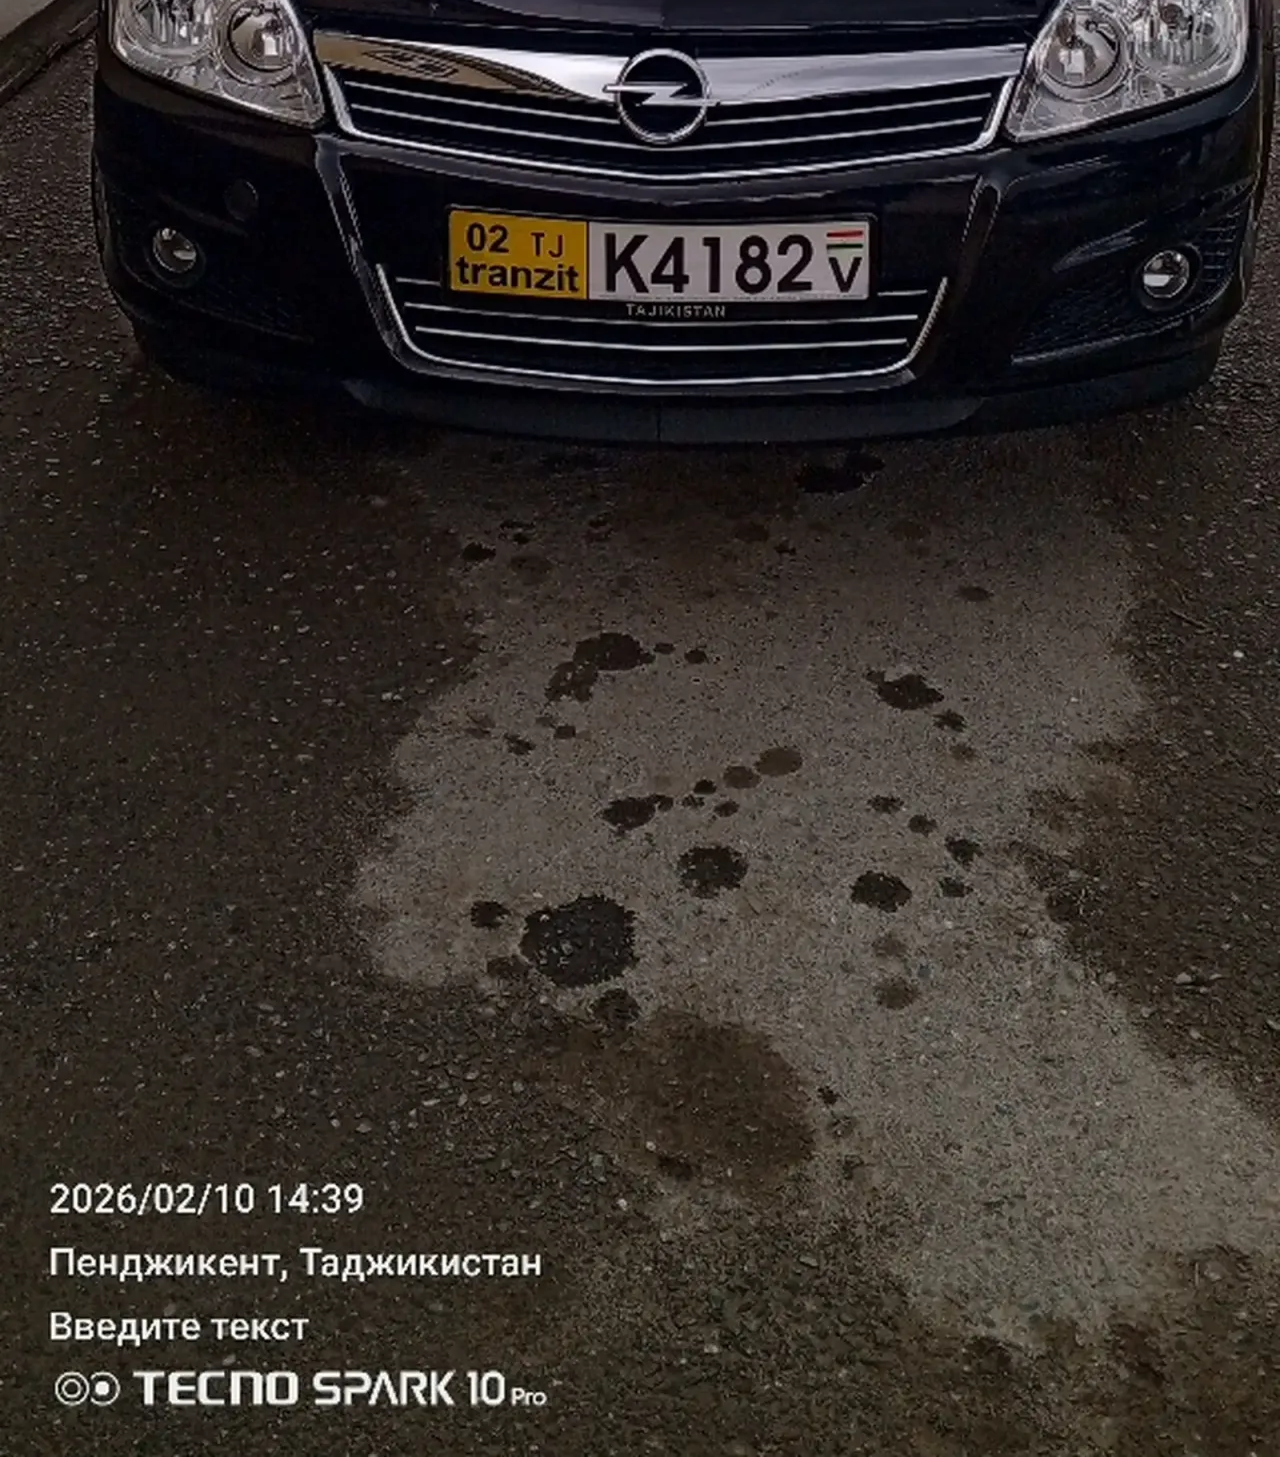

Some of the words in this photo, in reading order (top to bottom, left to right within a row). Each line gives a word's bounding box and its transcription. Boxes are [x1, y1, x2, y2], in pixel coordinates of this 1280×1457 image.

[466, 222, 509, 254] 02
[530, 232, 564, 258] TJ
[455, 255, 580, 293] tranzit
[604, 232, 814, 294] K4182
[626, 303, 726, 318] TAJIKISTAN
